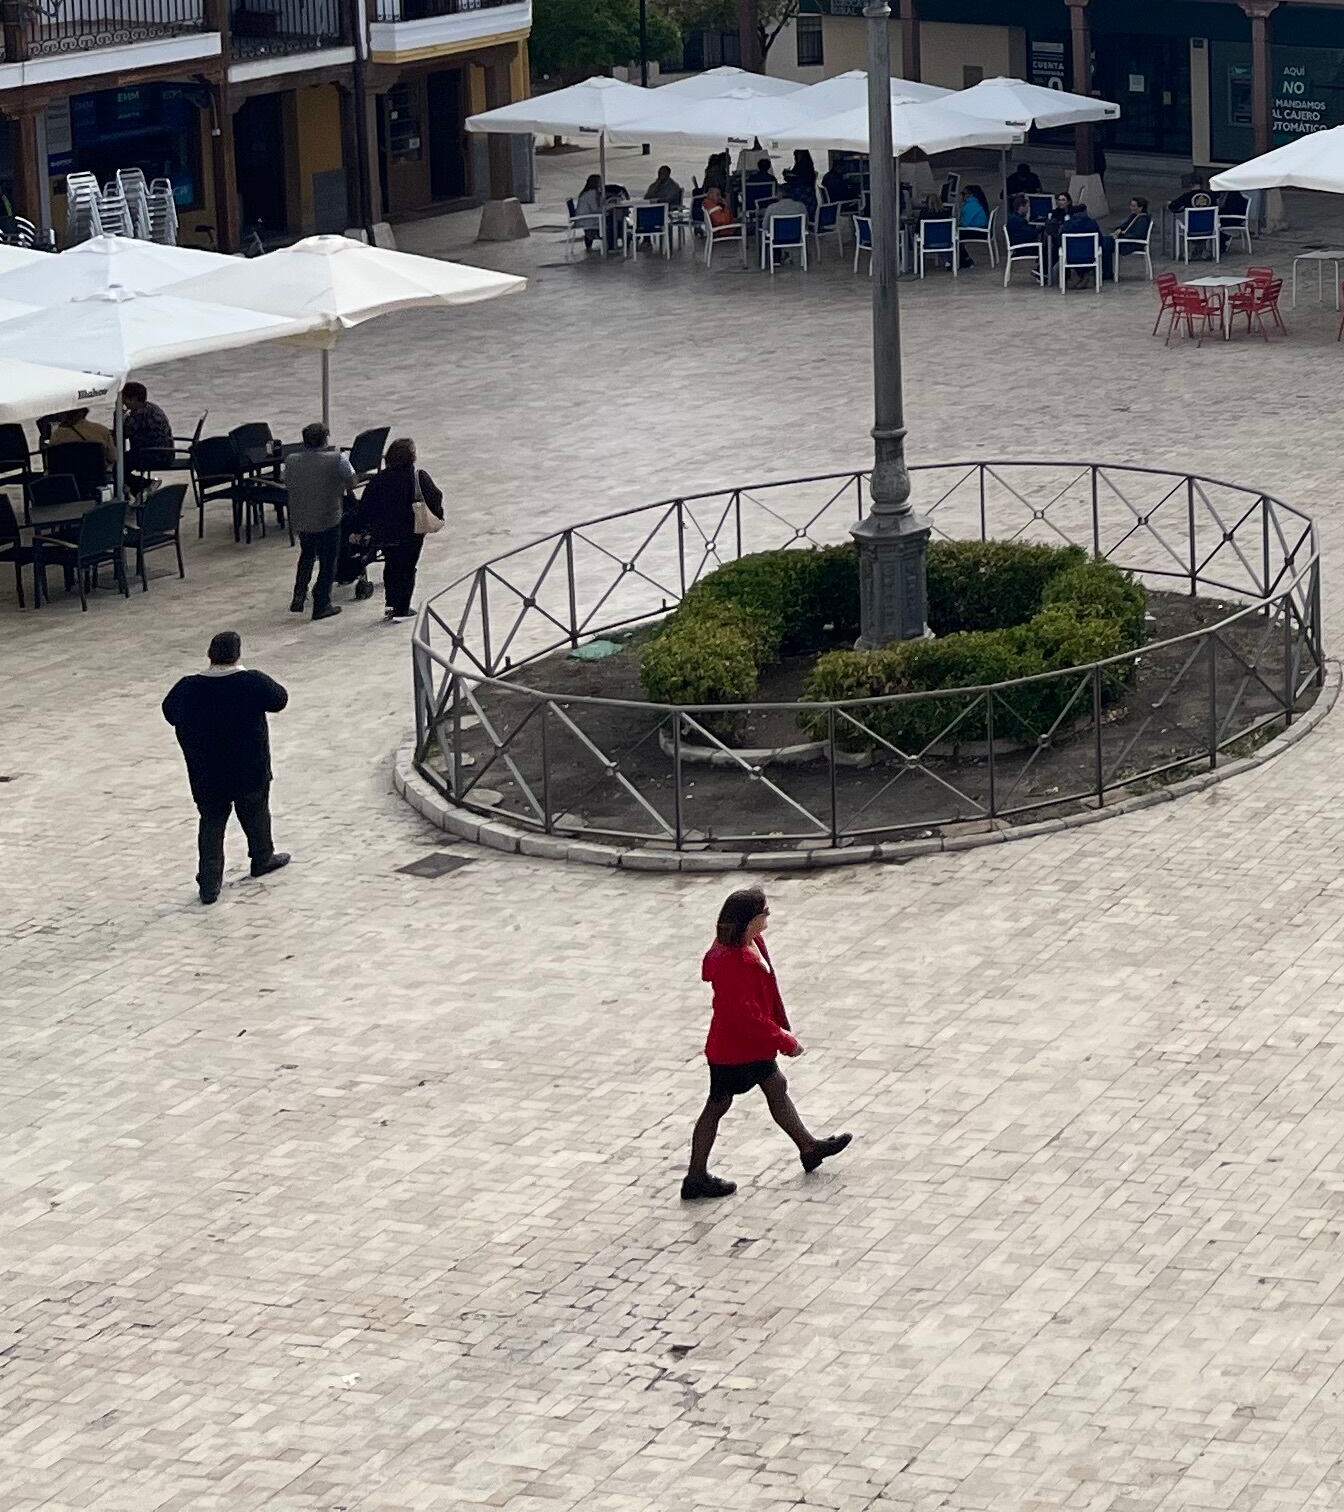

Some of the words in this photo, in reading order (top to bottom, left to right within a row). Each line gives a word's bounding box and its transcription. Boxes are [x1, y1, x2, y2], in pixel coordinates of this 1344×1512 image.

[1032, 60, 1065, 70] CUENTA
[1282, 80, 1305, 94] NO
[1275, 98, 1326, 110] MANDAMOS
[1283, 109, 1321, 121] CAJERO
[1272, 121, 1328, 133] UTOMÁTICO
